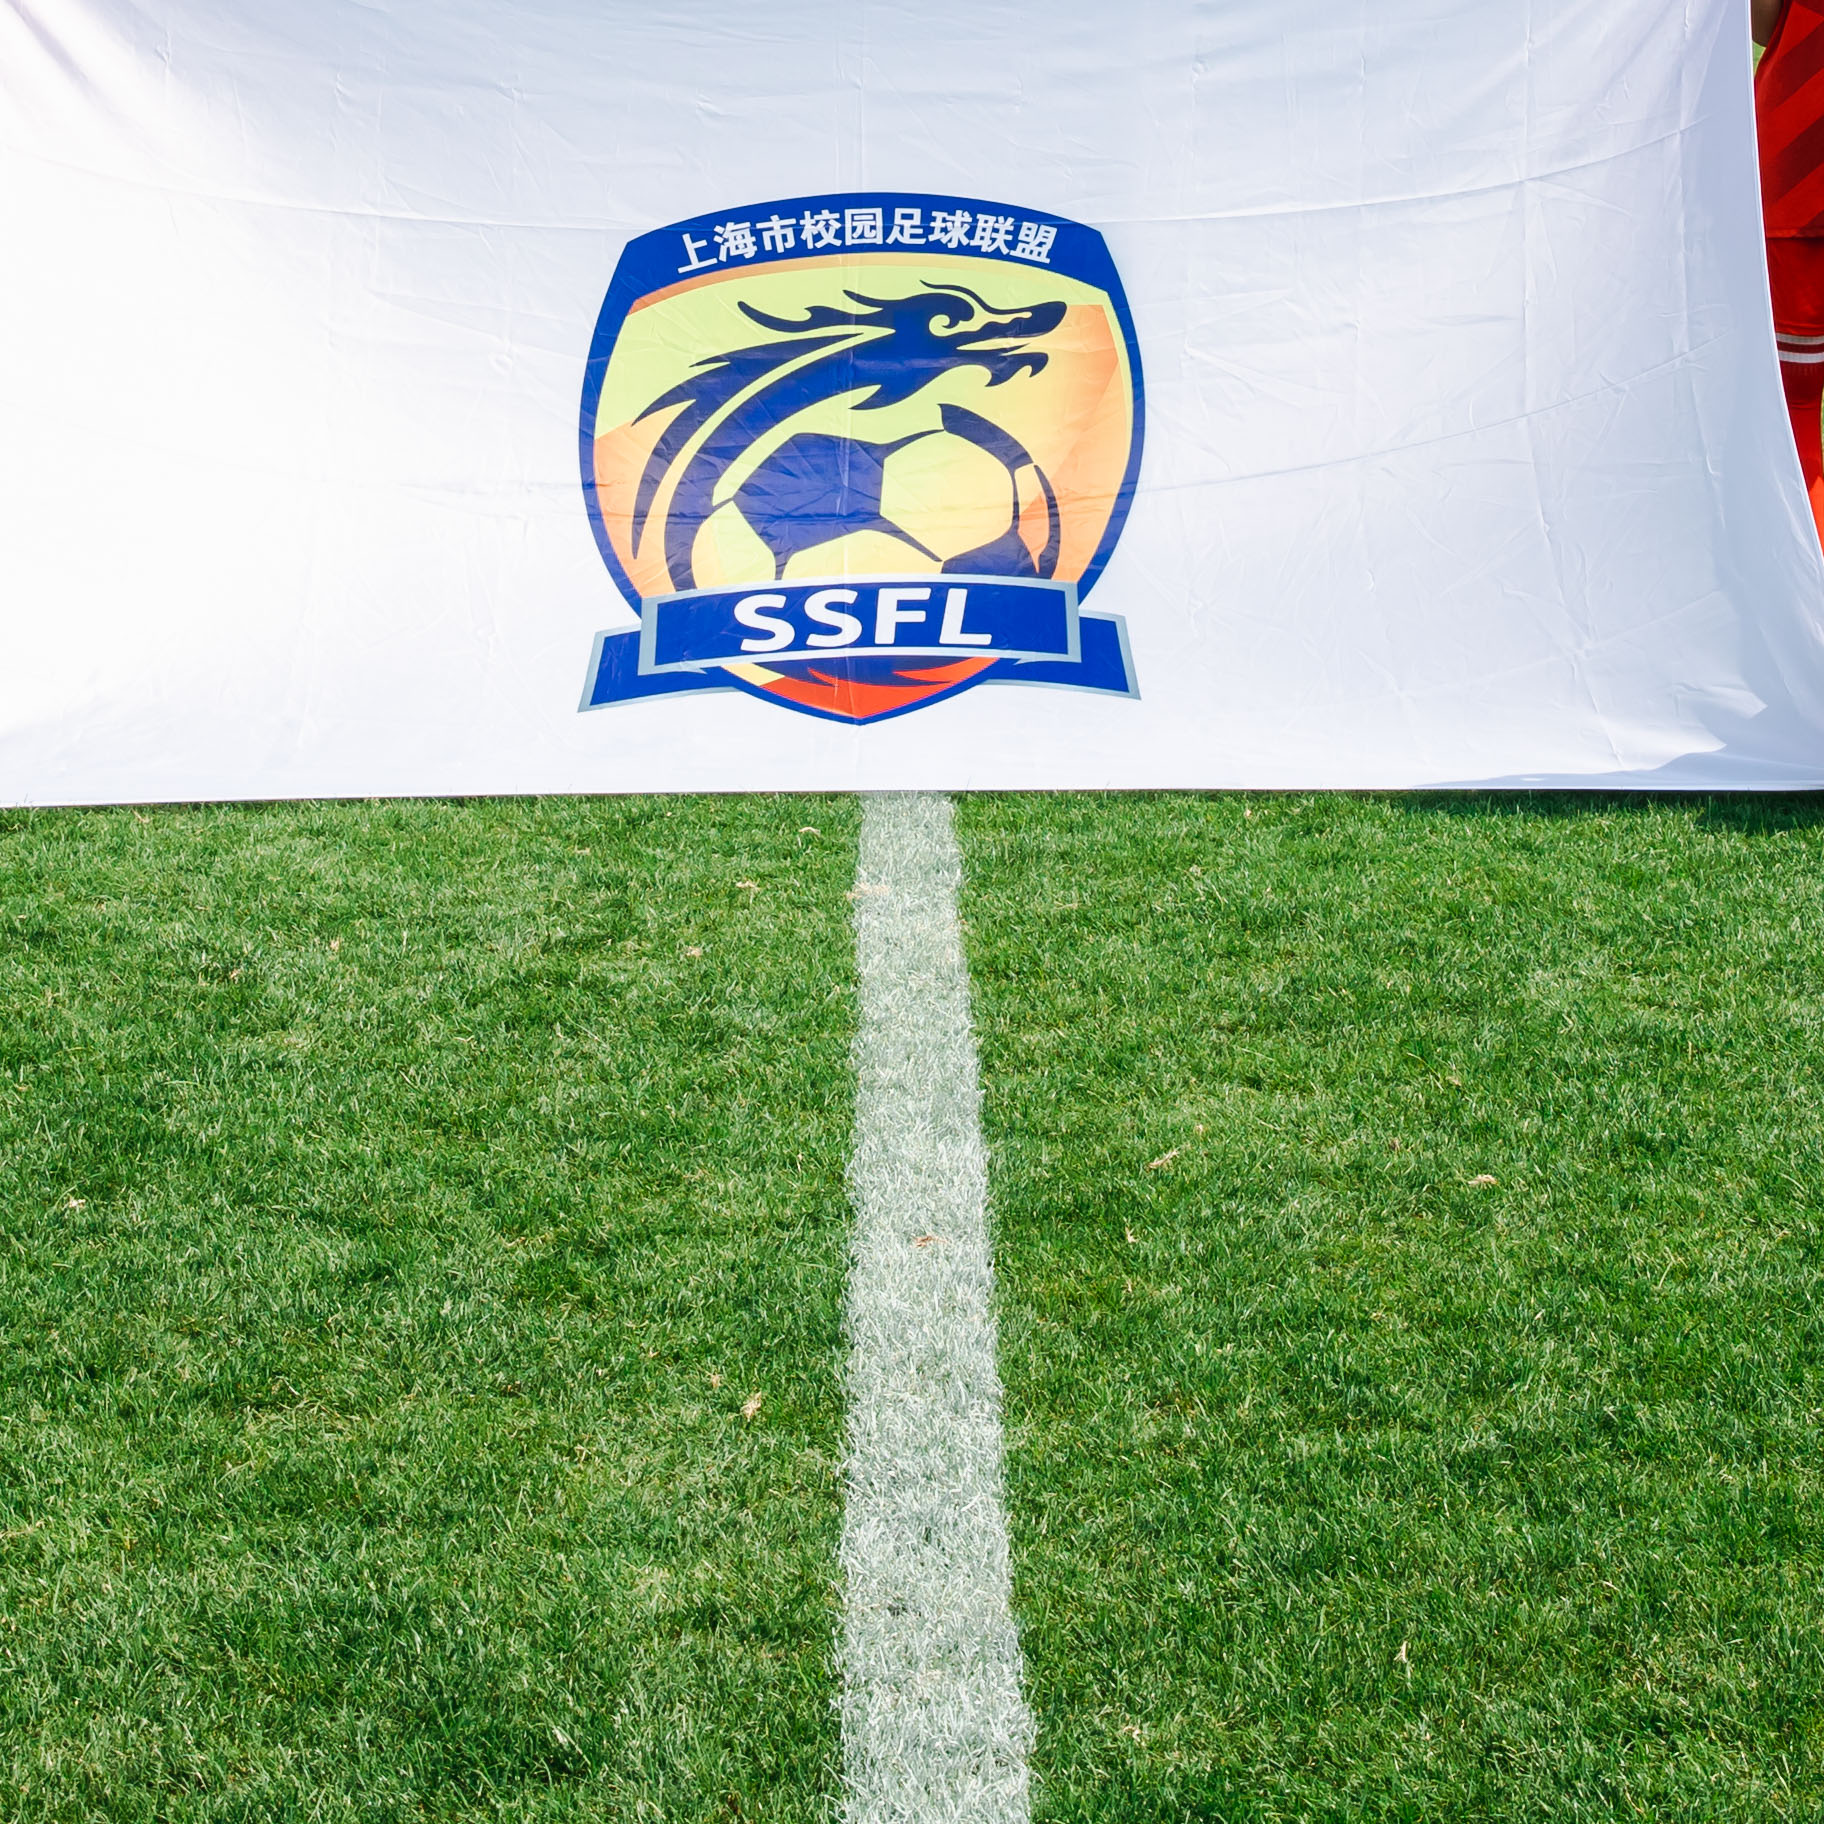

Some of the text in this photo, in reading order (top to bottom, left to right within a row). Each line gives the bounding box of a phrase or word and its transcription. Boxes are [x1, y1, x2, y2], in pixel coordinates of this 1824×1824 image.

[677, 207, 1058, 274] 上海市校园足球联盟
[732, 586, 993, 653] SSFL
